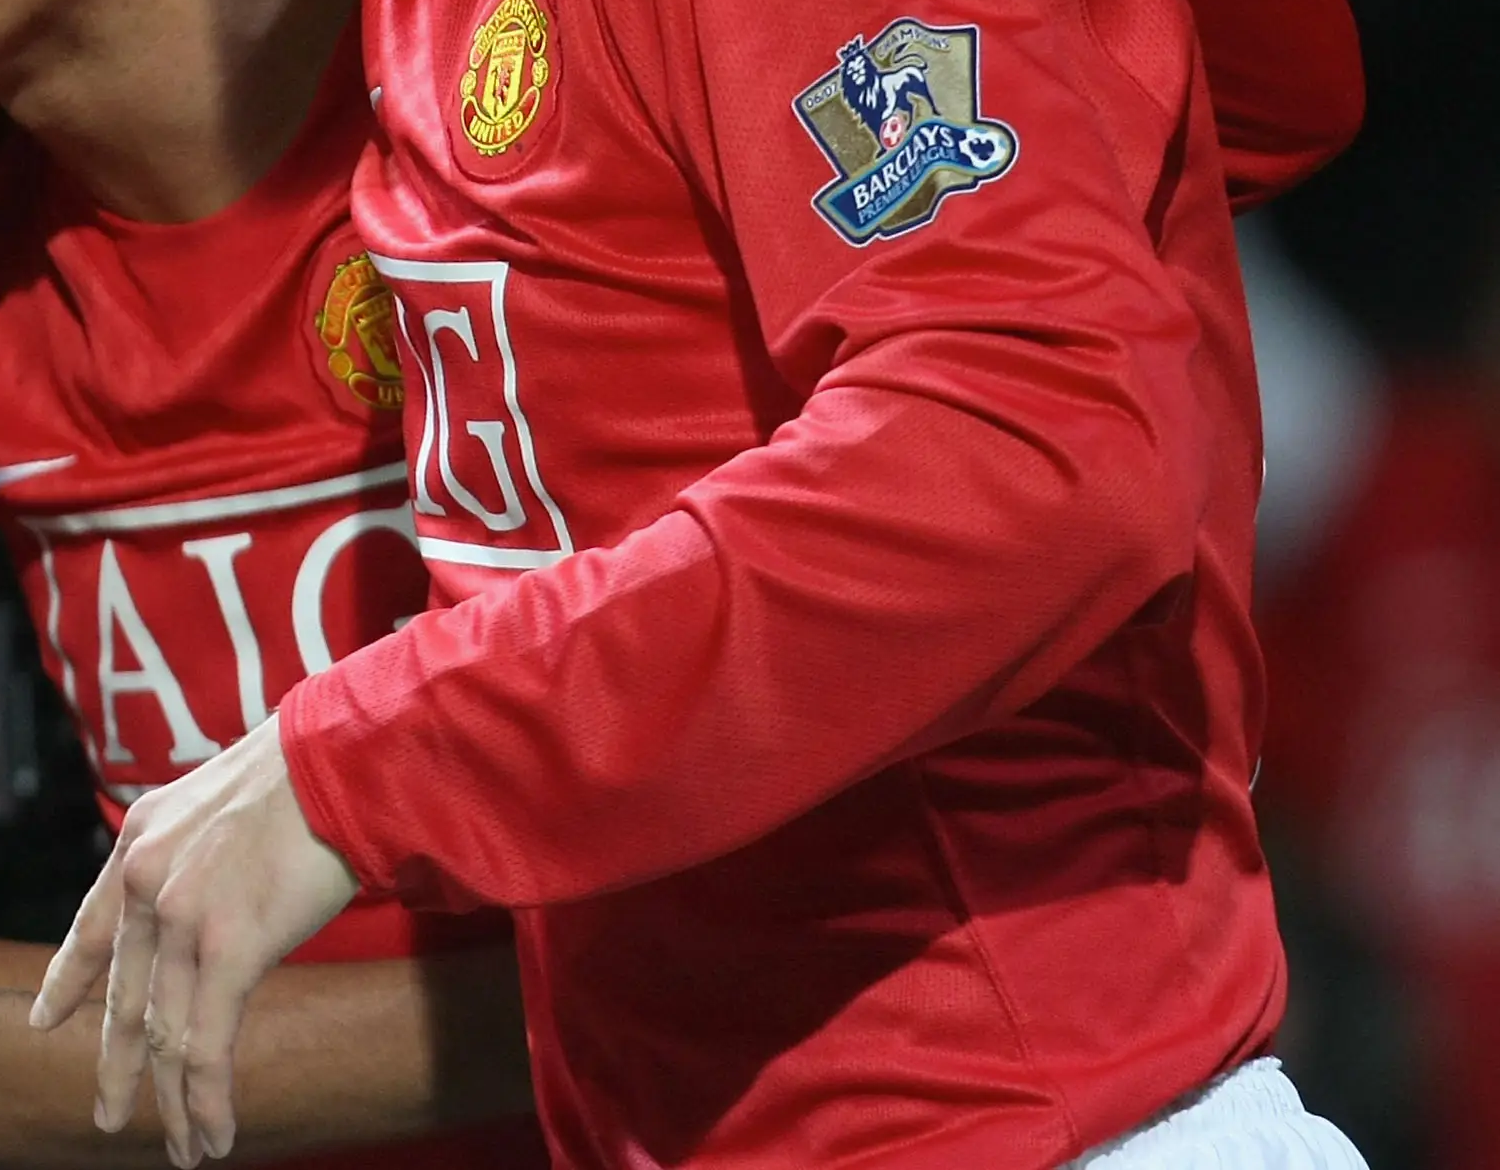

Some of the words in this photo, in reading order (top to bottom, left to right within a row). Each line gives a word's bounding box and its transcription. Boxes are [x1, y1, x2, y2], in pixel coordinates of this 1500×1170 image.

[805, 81, 839, 110] 06/07
[875, 27, 951, 57] CHAMPIONS
[469, 110, 524, 144] UNITED
[852, 124, 955, 210] BARCLAYS
[857, 176, 911, 225] PREMIER
[909, 146, 959, 182] LEAGUE
[393, 293, 528, 532] IG
